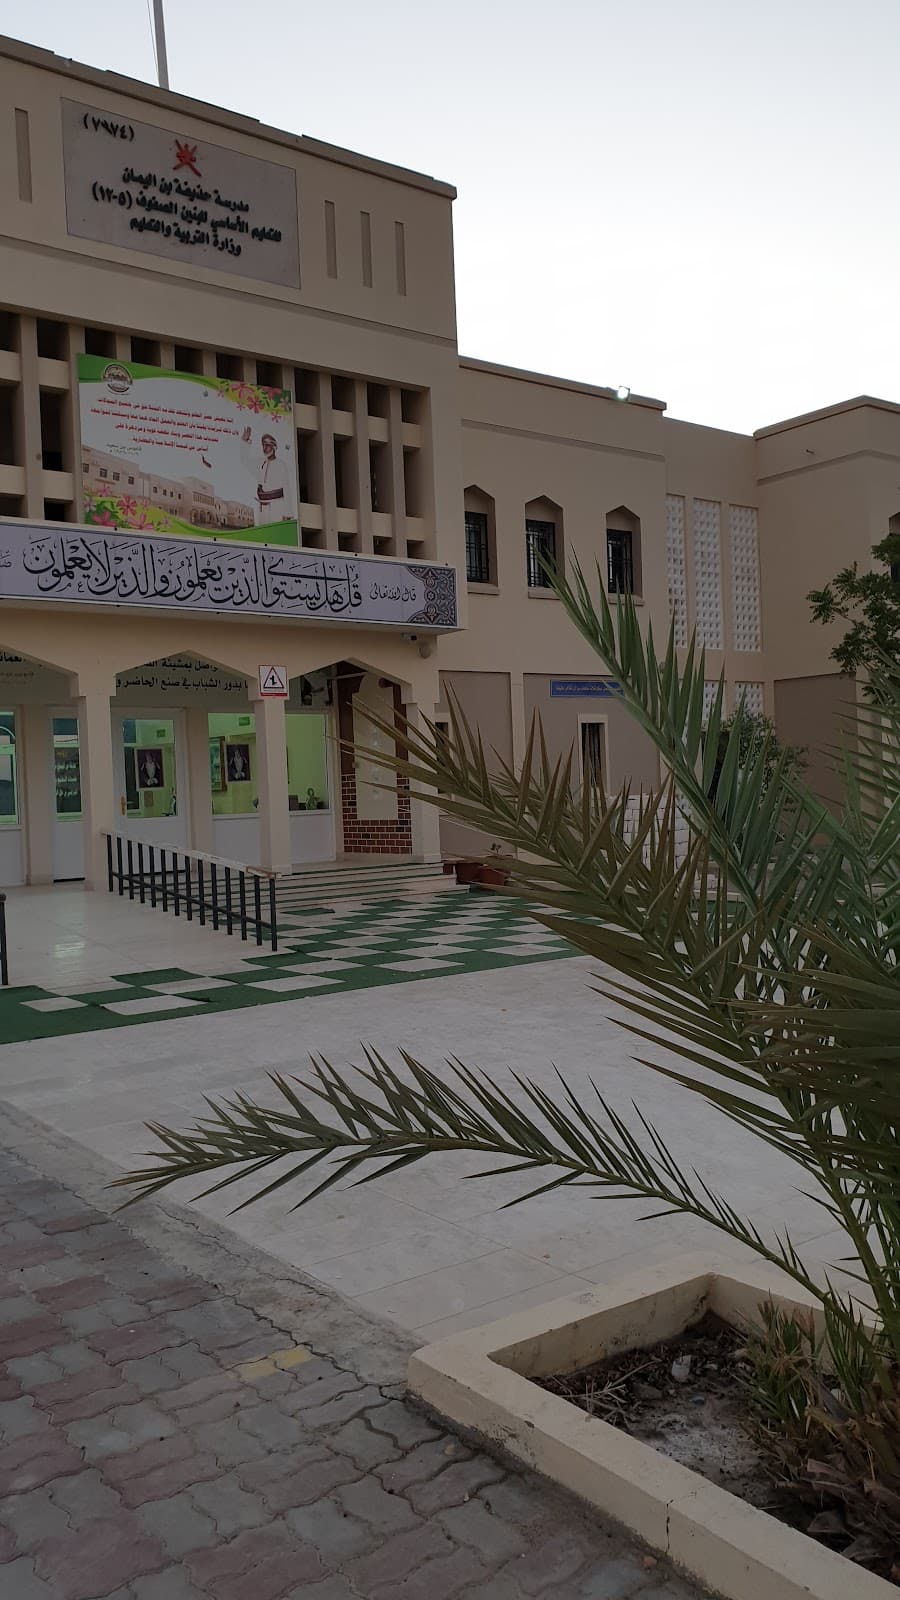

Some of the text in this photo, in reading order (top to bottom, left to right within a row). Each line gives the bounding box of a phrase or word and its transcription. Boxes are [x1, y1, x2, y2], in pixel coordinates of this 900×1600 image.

[122, 167, 249, 212] مدرسة حذيفة بن اليمان
[136, 190, 178, 215] الصفوف
[180, 205, 208, 225] للبنين
[129, 215, 242, 257] وزارة التربية والتعليم
[251, 225, 282, 242] للتعليم
[123, 675, 158, 688] الحاضر
[161, 677, 180, 691] صنع
[193, 678, 221, 691] الشباب
